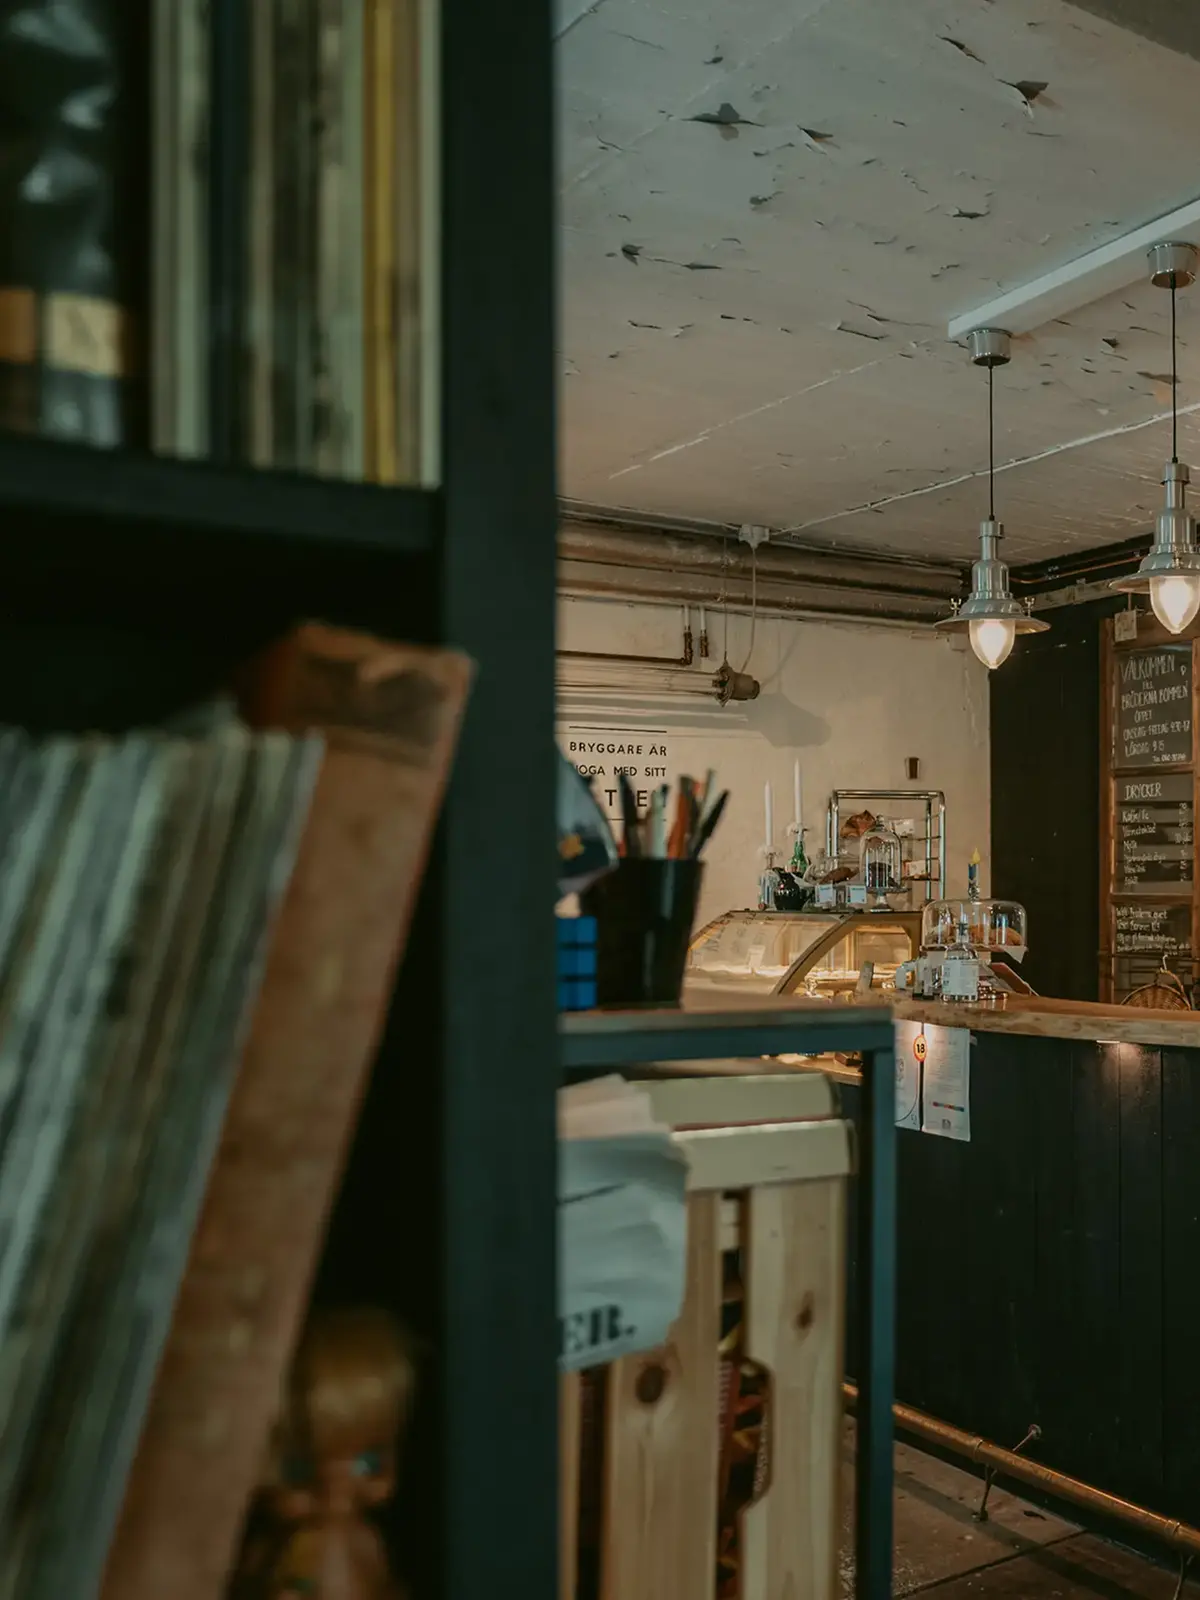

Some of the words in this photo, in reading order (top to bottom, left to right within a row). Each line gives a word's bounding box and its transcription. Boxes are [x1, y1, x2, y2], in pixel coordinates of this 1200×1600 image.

[1119, 654, 1176, 685] VÄLKOMMEN
[569, 741, 644, 756] BRYGGARE
[648, 743, 668, 757] ÄR
[614, 766, 638, 777] MED
[645, 767, 668, 778] SITT
[915, 1042, 926, 1054] 18
